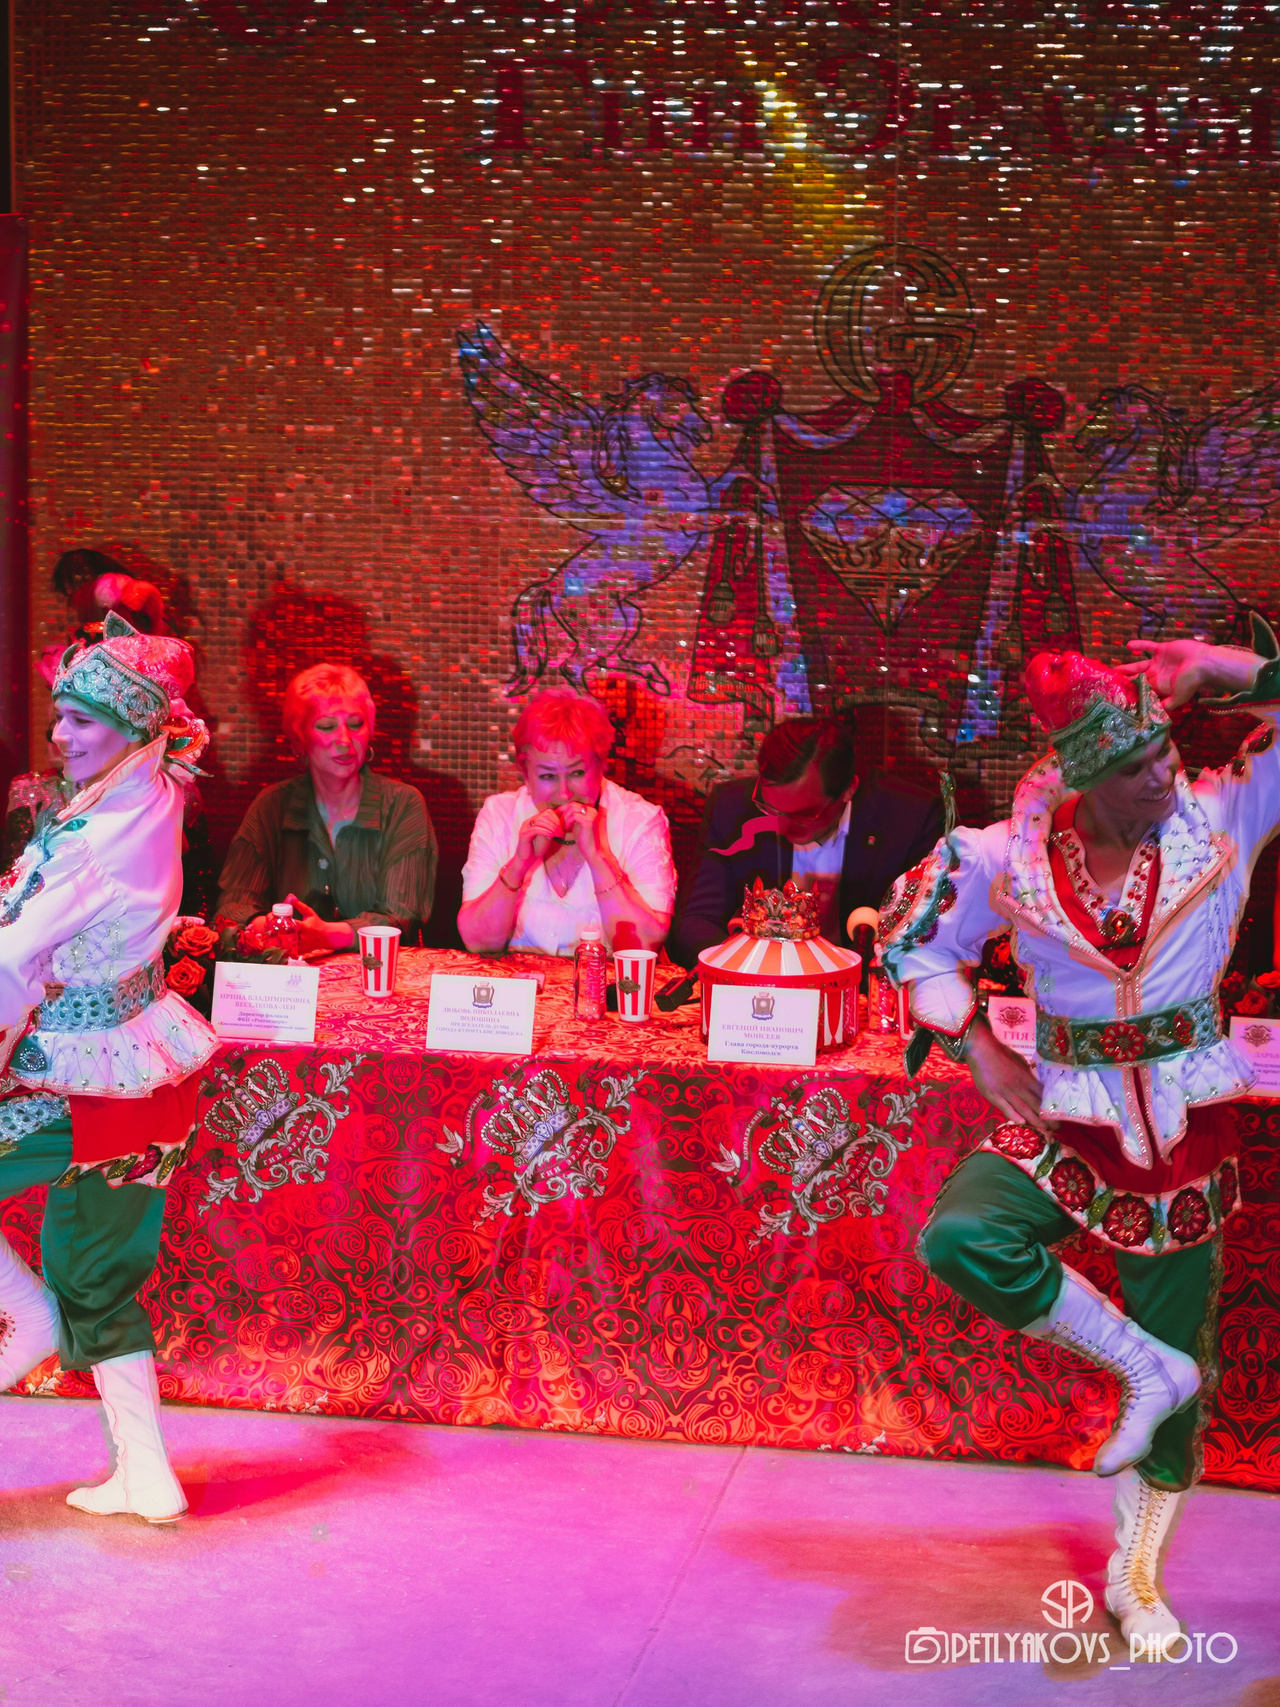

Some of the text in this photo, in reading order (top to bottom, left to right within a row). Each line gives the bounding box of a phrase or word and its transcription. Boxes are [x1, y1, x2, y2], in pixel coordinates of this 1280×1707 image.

[220, 993, 311, 1004] ИРИНА ВЛАДИМИРОВНА
[472, 1009, 520, 1017] НИКОЛАЕВНА
[460, 1015, 500, 1023] ВОЛОШИНА
[450, 1021, 492, 1029] ПРЕДСЕДАТЕЛЬ
[722, 1023, 803, 1034] ЕВГЕНИЙ ИВАНОВИЧ
[743, 1032, 781, 1040] МОИСЕЕВ
[1003, 1030, 1029, 1041] ГИЯ
[234, 1043, 270, 1057] ЦИРК
[746, 1042, 799, 1050] города-курорта
[741, 1048, 782, 1056] Кисловодск
[466, 1093, 485, 1142] КОРОЛЕВСКИЙ
[743, 1072, 830, 1161] КОРОЛЕВСКИЙ ЦИРК
[263, 1119, 312, 1165] ГИИ ЭРАДЗЕ
[541, 1132, 592, 1179] ГИИ ЭРАДЗЕ
[819, 1149, 872, 1198] ГИИ ЭРАДЗЕ
